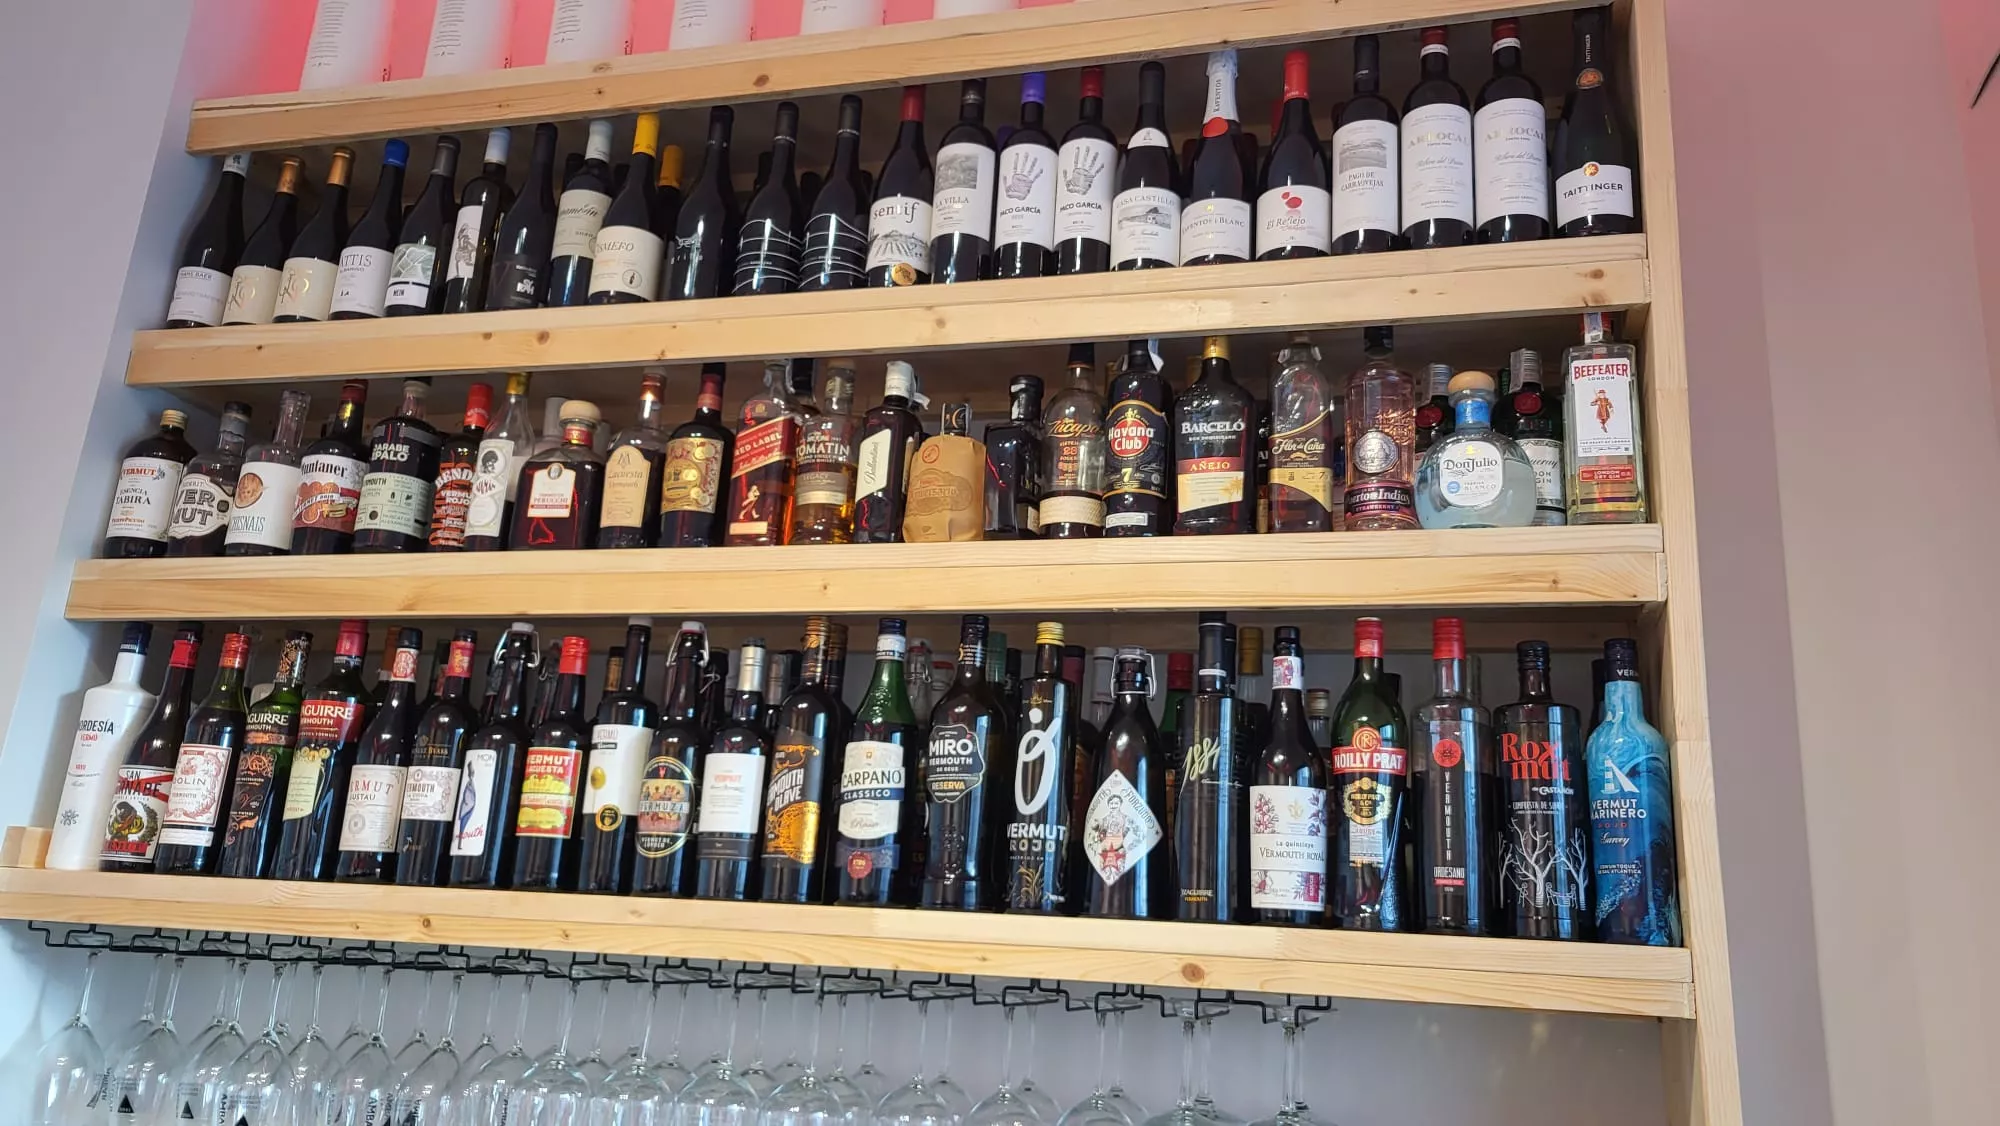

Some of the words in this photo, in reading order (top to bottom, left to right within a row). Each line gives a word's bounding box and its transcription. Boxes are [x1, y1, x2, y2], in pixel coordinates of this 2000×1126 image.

[1366, 171, 1375, 179] DE
[1563, 183, 1624, 199] TAITTINGER
[1076, 201, 1102, 211] GARCÍA
[1573, 363, 1630, 380] BEEFEATER
[1108, 425, 1154, 441] Havana
[1181, 418, 1245, 435] BARCELÓ
[752, 432, 783, 449] LABEL
[1115, 437, 1143, 451] Club
[1272, 438, 1296, 455] Flor
[1304, 437, 1326, 454] Caña
[796, 442, 850, 457] TOMATIN
[1190, 460, 1230, 472] AÑEJO
[1121, 467, 1133, 483] 7
[929, 733, 974, 757] MIRÓ
[929, 756, 973, 766] VERMOUTH
[1333, 750, 1371, 770] NOILLY
[1372, 751, 1404, 770] PRAT
[125, 769, 142, 781] SAN
[842, 768, 902, 789] CARPANO
[931, 780, 965, 791] RESERVA
[774, 785, 802, 812] OLAVE
[843, 787, 891, 801] CLASSICO
[1591, 798, 1639, 811] VERMUT
[1444, 770, 1454, 862] VERMOUTH
[1007, 822, 1066, 841] VERMUT
[1009, 838, 1056, 853] ROJO
[1259, 847, 1305, 860] VERMOUTH
[1306, 852, 1326, 862] ROYAL
